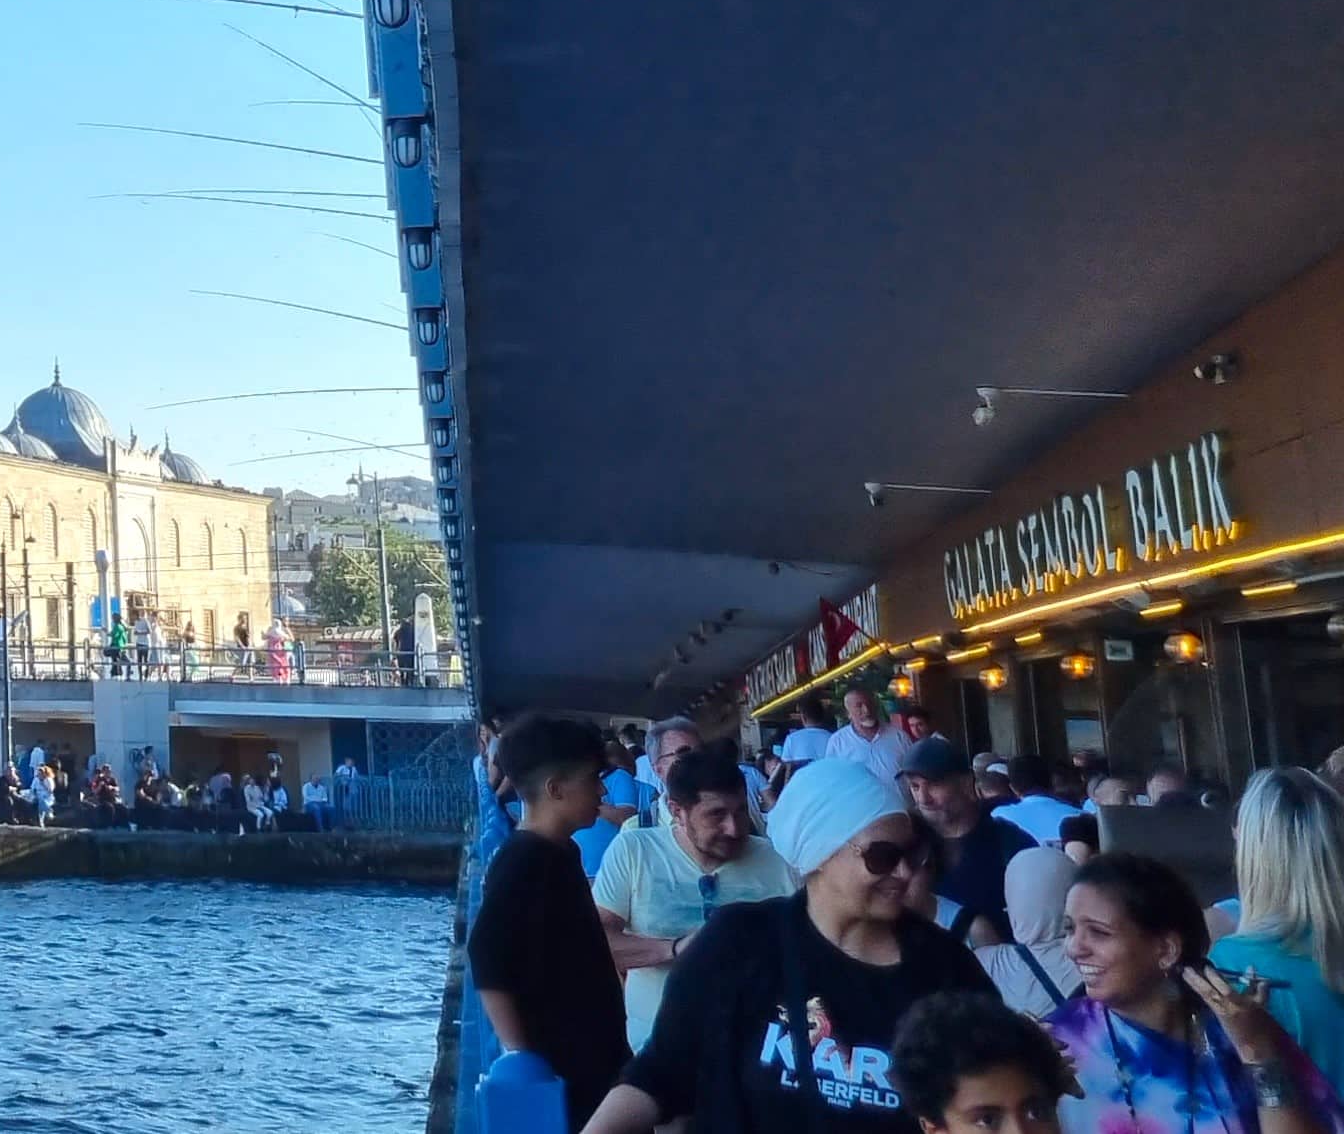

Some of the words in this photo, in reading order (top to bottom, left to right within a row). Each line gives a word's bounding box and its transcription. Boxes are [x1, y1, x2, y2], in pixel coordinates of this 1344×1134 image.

[944, 524, 1015, 618] GALATA
[1017, 483, 1116, 596] SEMBOL
[1126, 432, 1232, 561] BALIK
[759, 1022, 893, 1090] KAR
[780, 1069, 900, 1108] LERFELD
